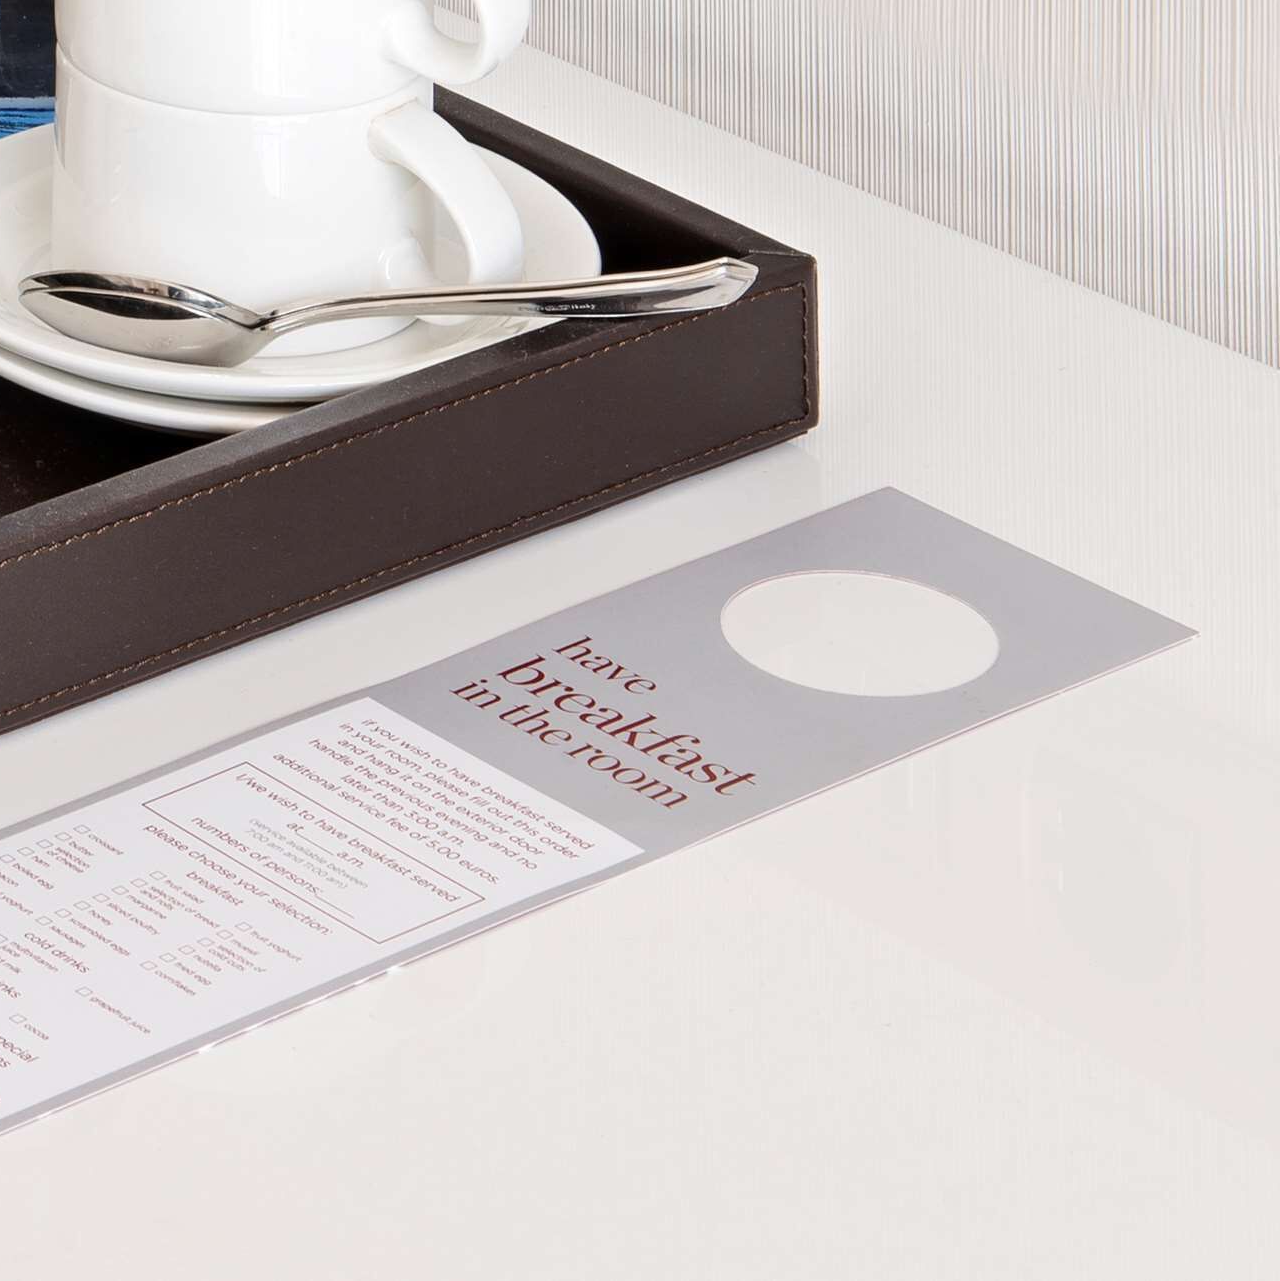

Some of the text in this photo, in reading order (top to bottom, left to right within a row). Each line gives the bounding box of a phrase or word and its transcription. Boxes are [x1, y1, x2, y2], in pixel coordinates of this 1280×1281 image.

[554, 636, 656, 693] have
[450, 678, 687, 808] in the room
[499, 656, 754, 793] breakfast
[272, 753, 342, 792] additional
[336, 790, 386, 820] service
[384, 816, 410, 833] fee
[408, 831, 431, 841] of
[308, 738, 538, 870] handle the previous evening and no
[336, 739, 546, 855] and hang it on the exterior door
[338, 722, 355, 733] in
[350, 730, 387, 749] your
[421, 771, 469, 798] please
[467, 795, 491, 808] fill
[486, 806, 514, 822] out
[512, 819, 540, 837] this
[538, 836, 580, 859] order
[339, 774, 465, 848] later than 3:00 a.m.
[360, 718, 595, 850] if you wish to have breakfast served
[142, 824, 189, 851] please
[187, 850, 237, 880] choose
[232, 878, 270, 897] your
[190, 817, 253, 854] numbers
[248, 851, 271, 862] of
[267, 791, 299, 812] wish
[297, 809, 316, 821] to
[313, 818, 348, 840] have
[347, 837, 412, 876] breakfast
[409, 874, 461, 903] served
[285, 822, 364, 869] at a.m.
[185, 870, 244, 906] breakfast
[23, 932, 90, 973] cold drinks
